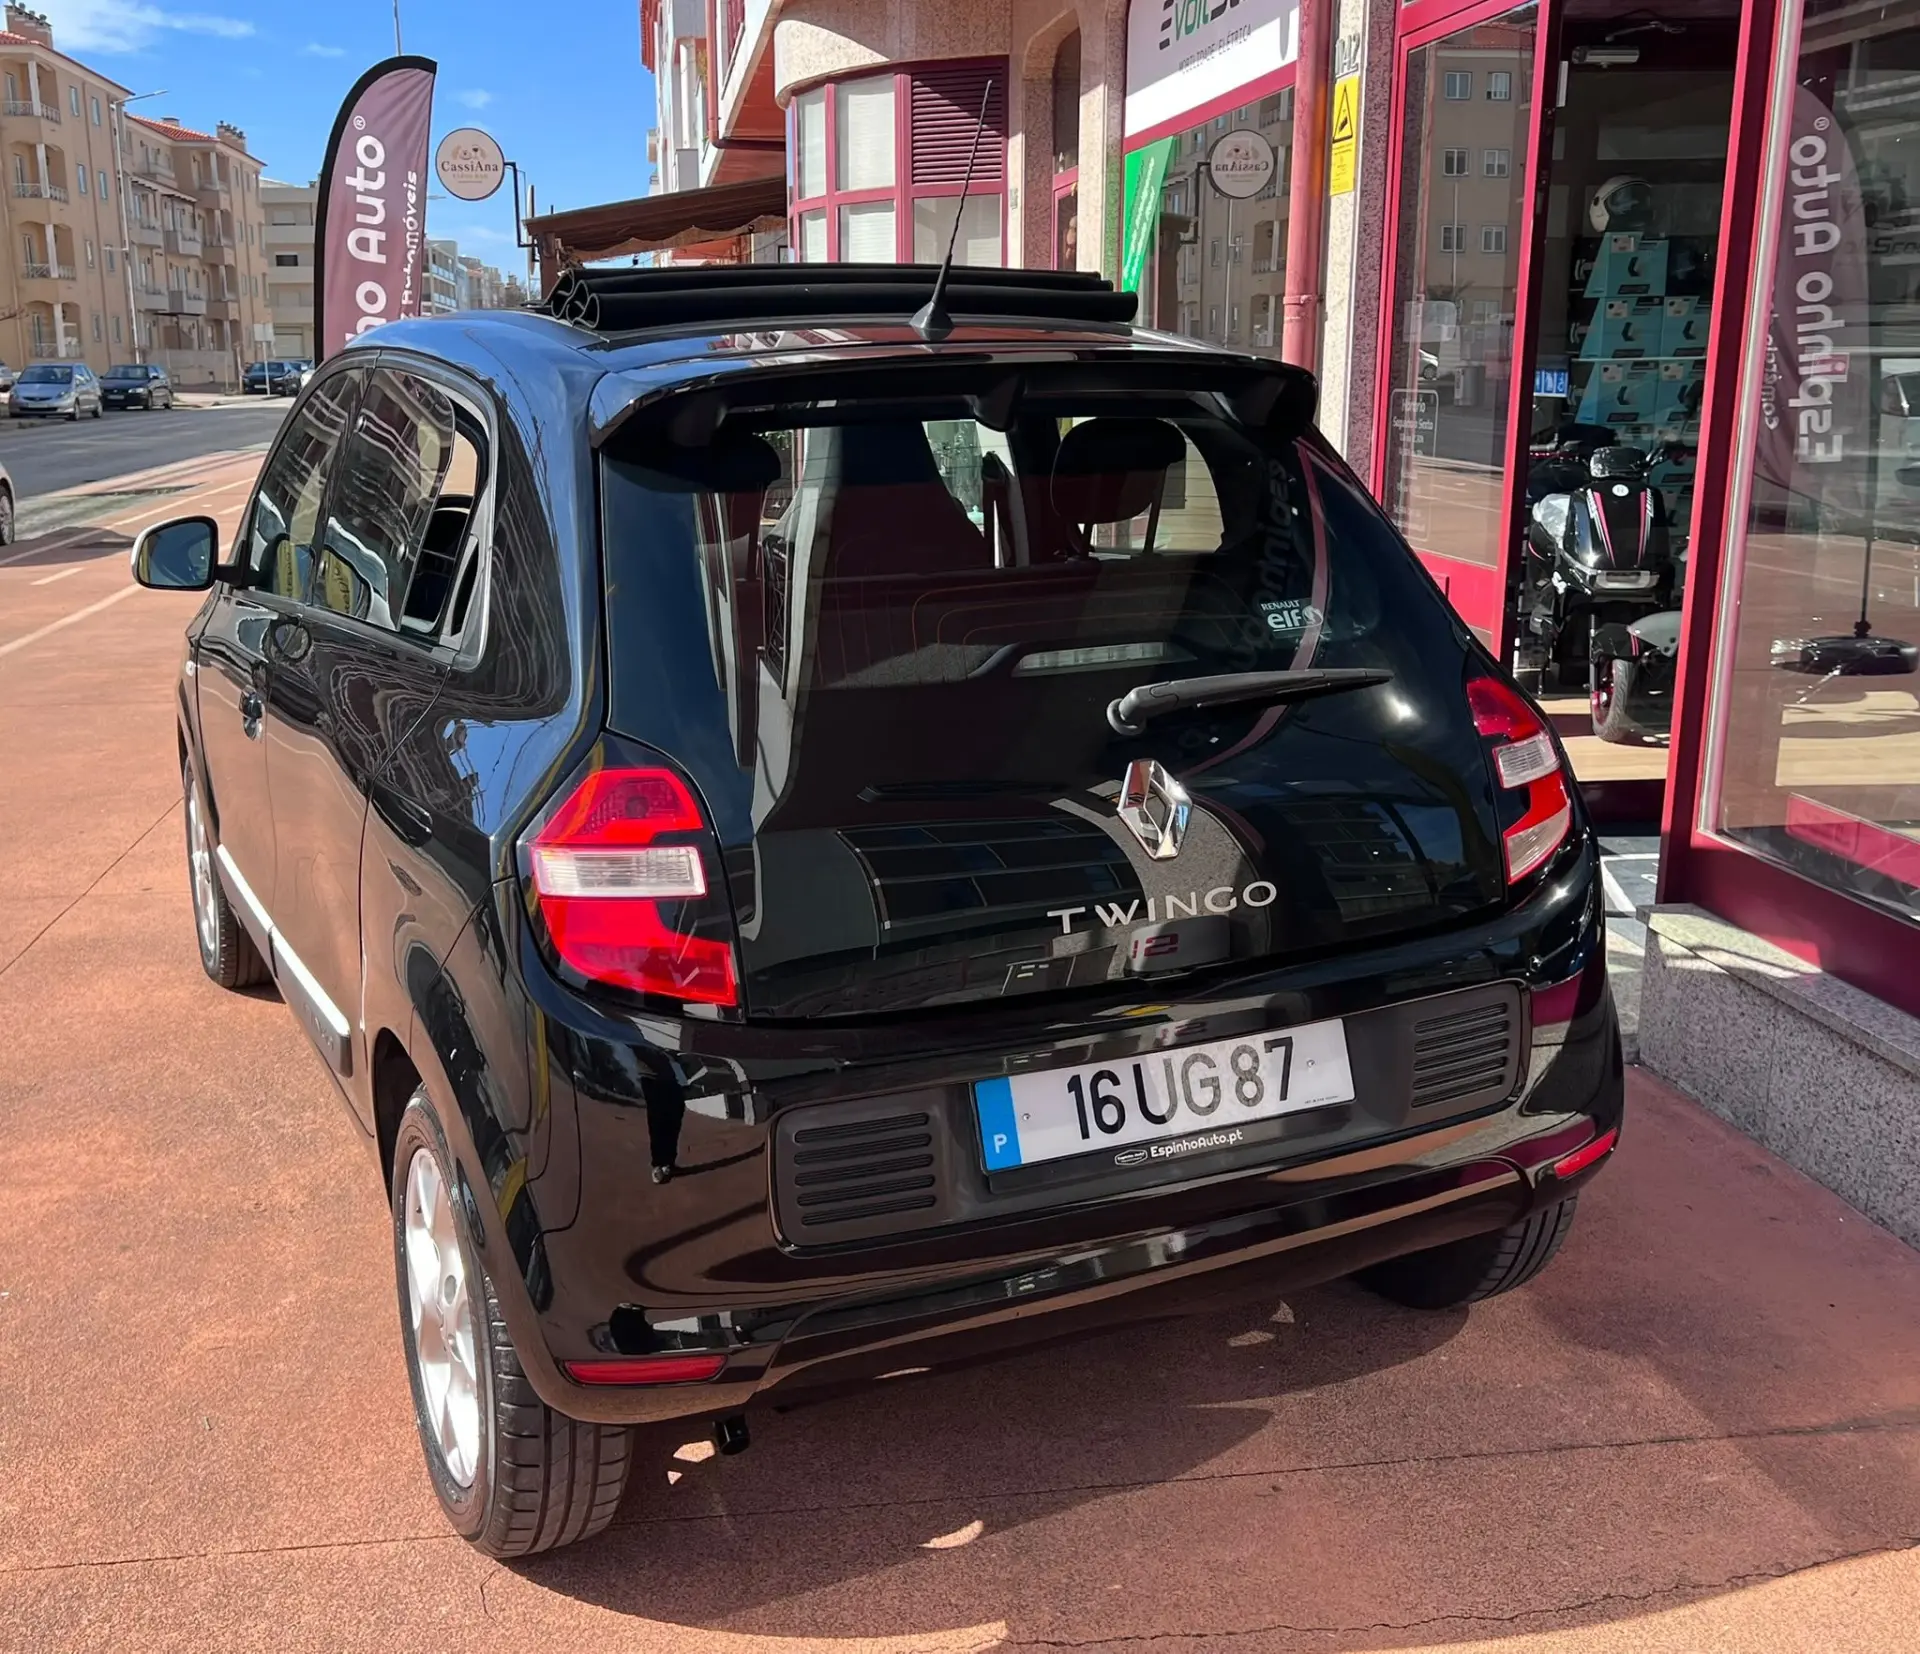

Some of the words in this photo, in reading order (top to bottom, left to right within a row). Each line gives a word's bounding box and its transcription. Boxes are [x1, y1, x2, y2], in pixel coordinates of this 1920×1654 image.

[441, 161, 499, 172] CassiAna
[1261, 599, 1301, 611] RENAULT
[1267, 609, 1302, 630] elf
[1047, 881, 1277, 934] TWINGO
[993, 1133, 1007, 1155] P
[1150, 1129, 1244, 1158] EspinhoAuto.pt
